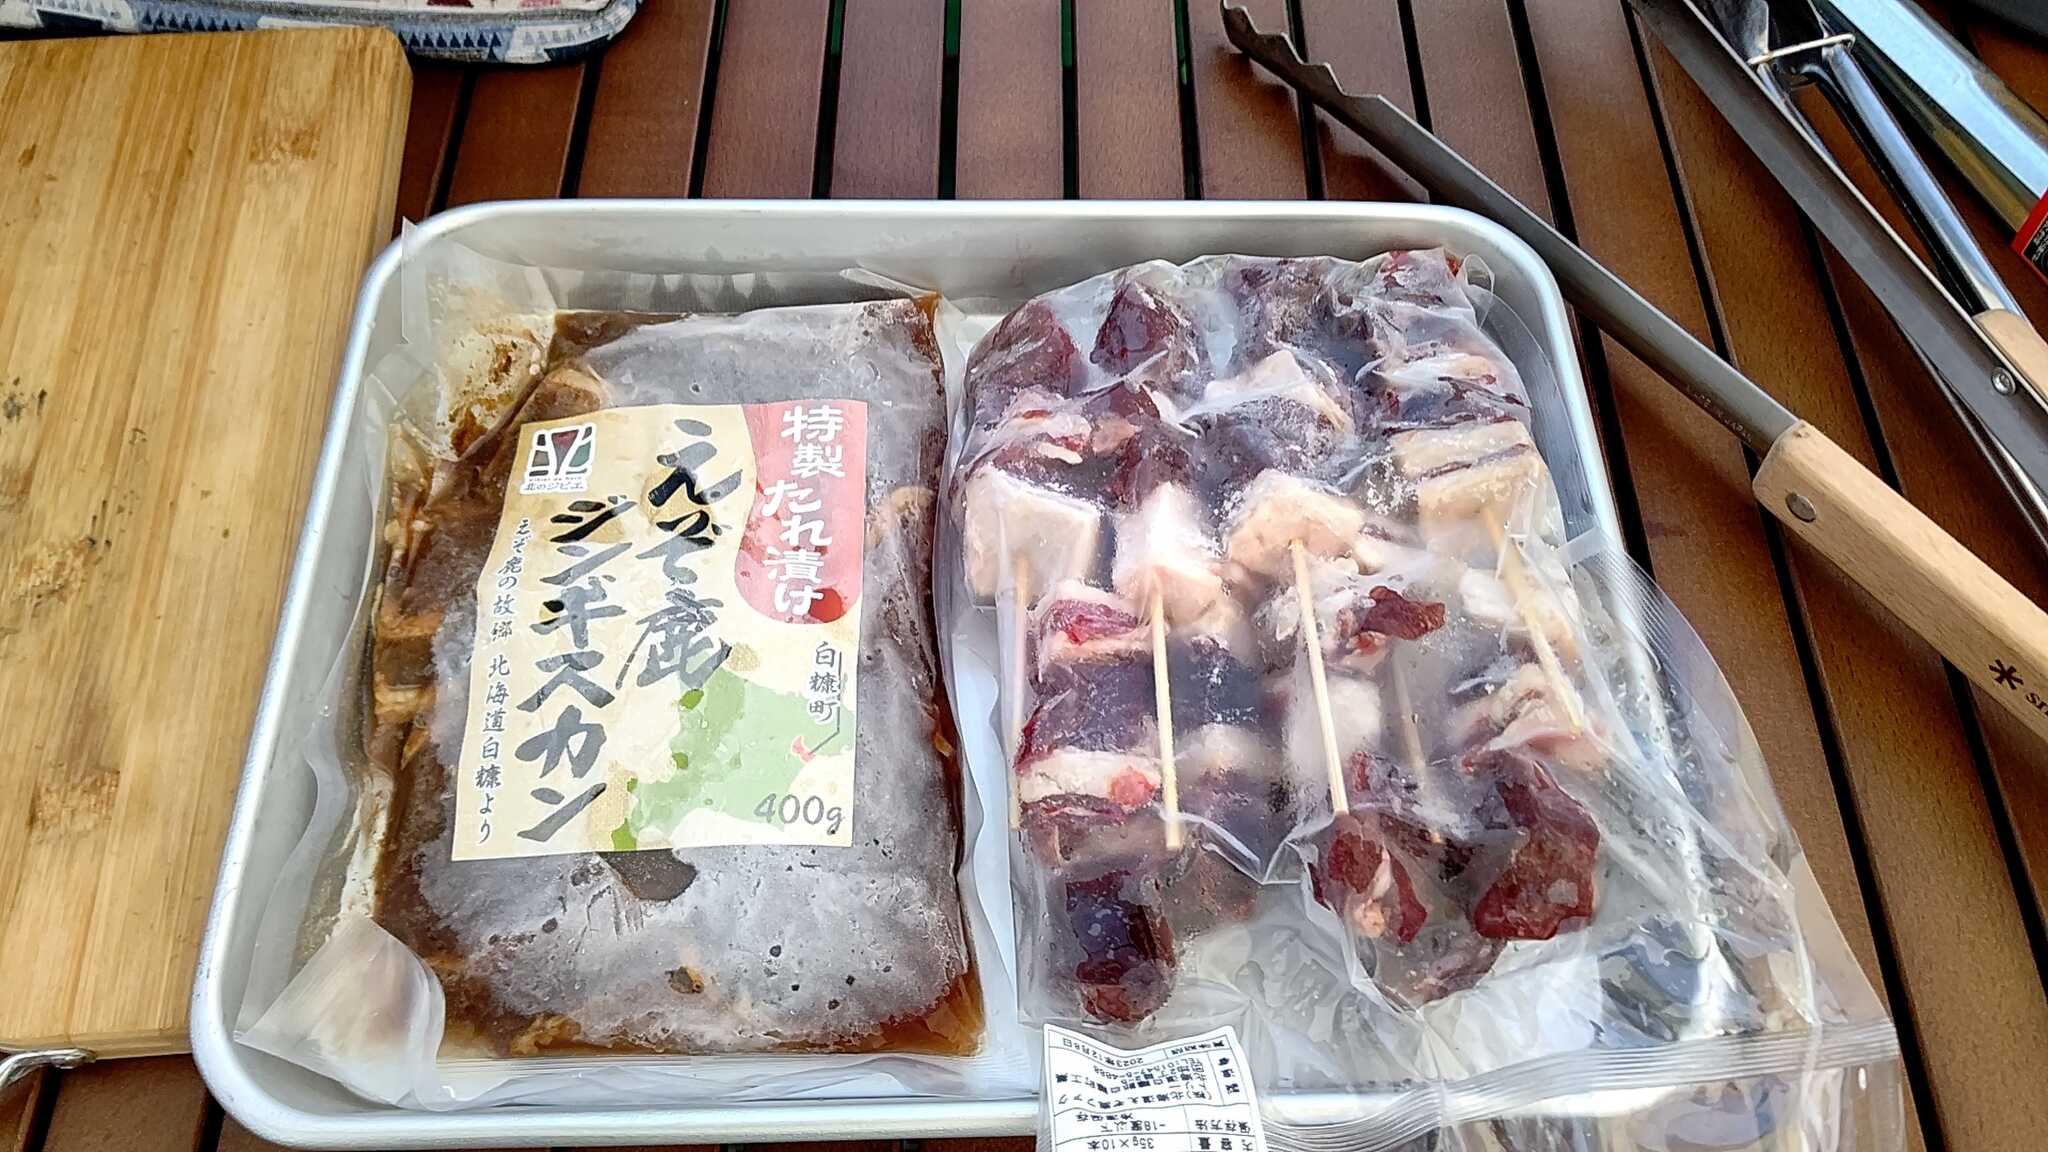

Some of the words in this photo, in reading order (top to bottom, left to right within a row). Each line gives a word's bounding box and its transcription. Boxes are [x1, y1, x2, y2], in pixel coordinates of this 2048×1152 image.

[615, 418, 744, 691] えぞ鹿
[762, 405, 845, 616] 特製たれ漬け
[475, 654, 511, 844] 北海道白糠より
[515, 494, 638, 843] ジンギスカン
[809, 640, 838, 723] 白糠町
[754, 793, 845, 836] 400g
